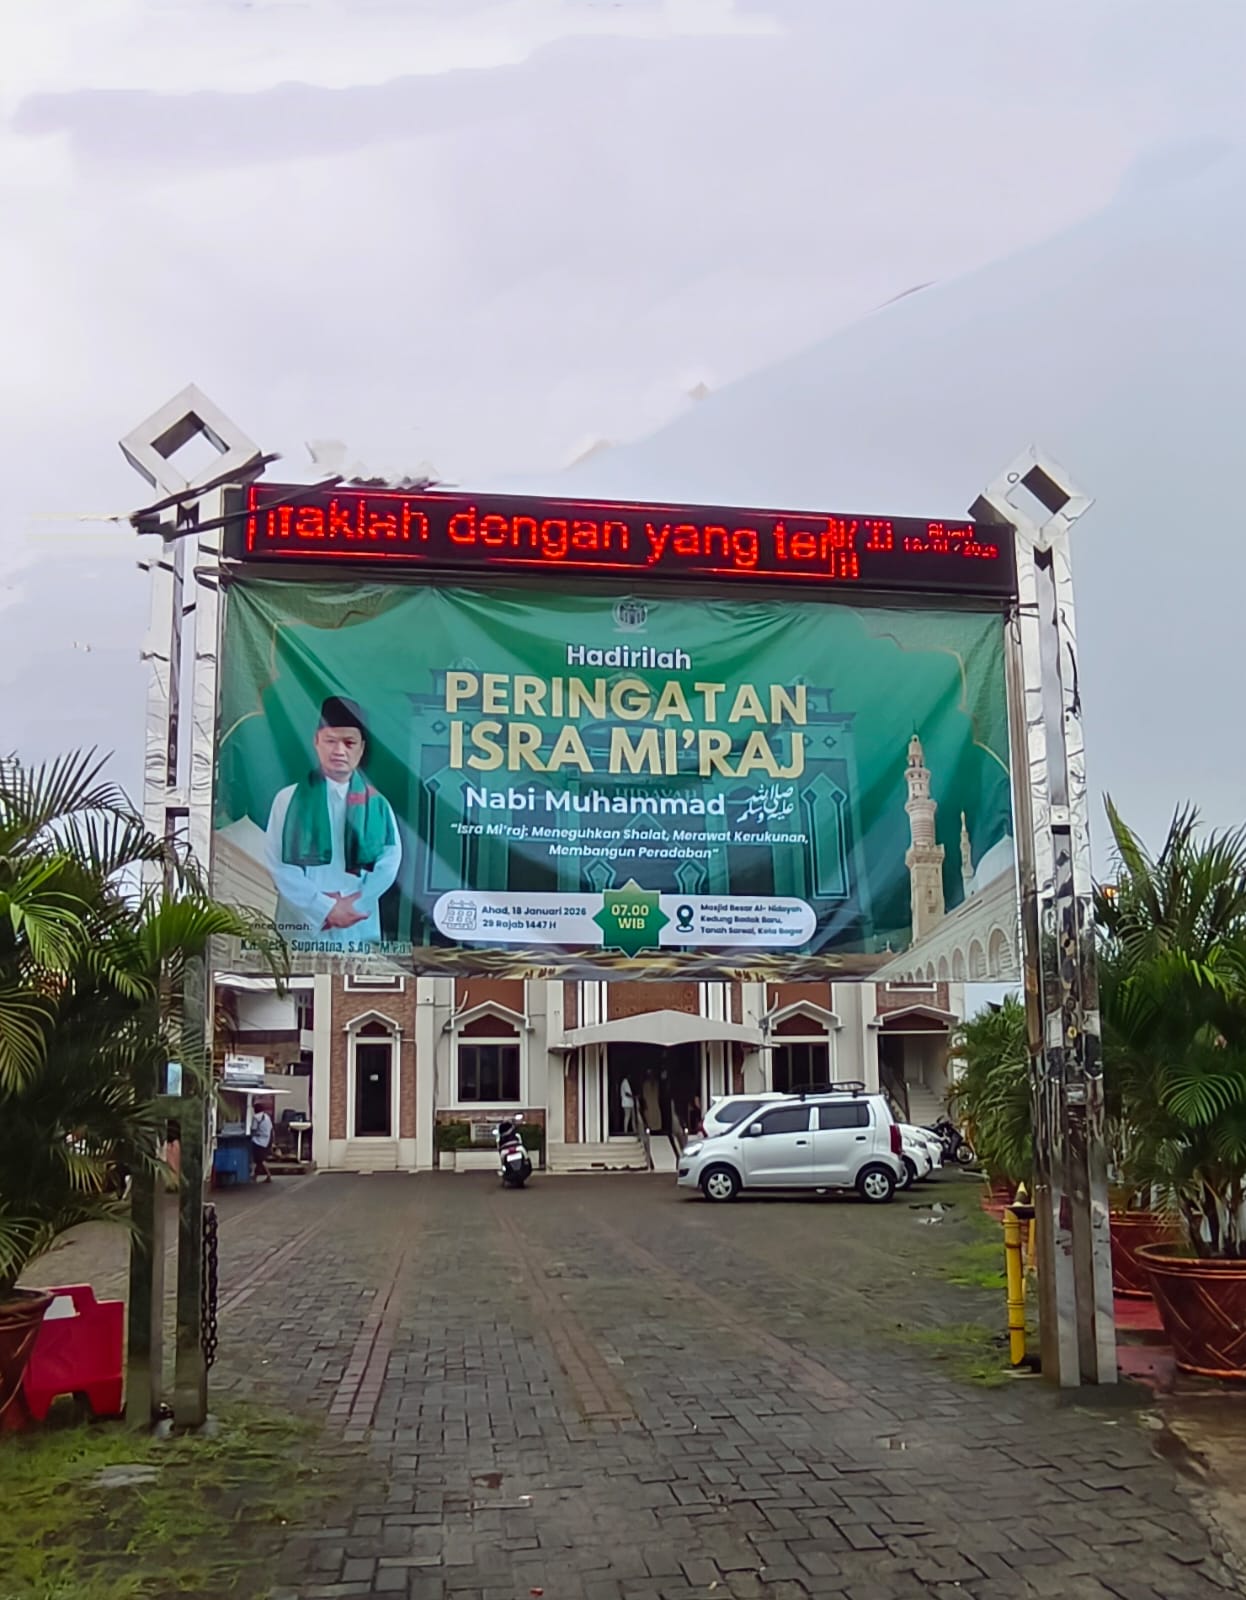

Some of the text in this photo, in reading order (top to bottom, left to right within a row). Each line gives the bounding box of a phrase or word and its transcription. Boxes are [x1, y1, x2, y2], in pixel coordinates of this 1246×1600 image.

[448, 506, 630, 558] dengan
[645, 521, 758, 568] yang
[566, 644, 692, 670] Hadirilah
[445, 671, 808, 726] PERINGATAN
[449, 719, 806, 781] ISRA MI'RAJ
[466, 787, 725, 816] Nabi Muhammad
[450, 823, 484, 835] "Isra
[531, 826, 621, 841] Meneguhkan
[623, 828, 670, 842] Shalat,
[672, 829, 731, 842] Merawat
[734, 831, 809, 845] Kerukunan,
[548, 844, 719, 860] Membangun Peradaban"
[481, 905, 587, 916] Ahad, 18 Januari 2026
[611, 904, 649, 917] 07.00
[700, 903, 728, 914] Masjid
[730, 904, 753, 912] Besar
[496, 919, 524, 931] Rajab
[525, 920, 547, 930] 1447
[618, 918, 646, 930] WIB
[700, 915, 732, 925] Kedung
[734, 916, 760, 924] Badak
[701, 926, 727, 935] Tanah
[757, 927, 777, 935] Kota
[291, 938, 346, 953] Supriatna,
